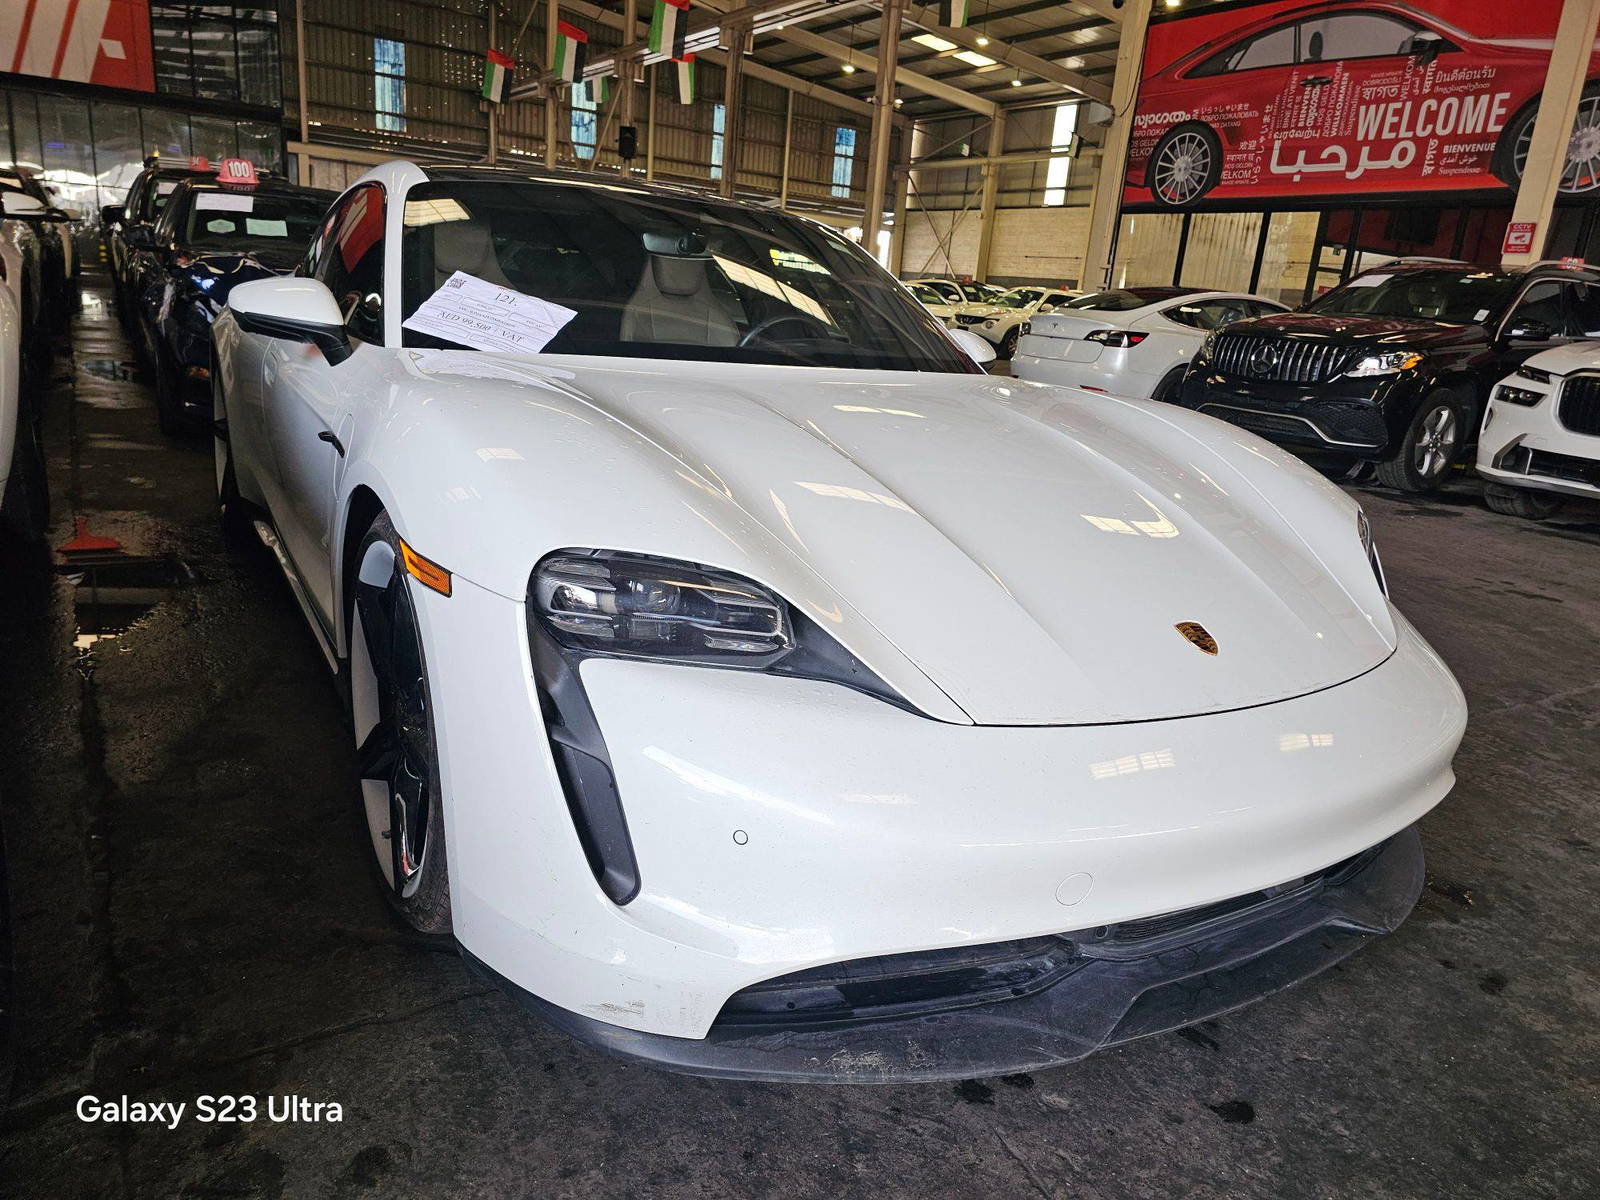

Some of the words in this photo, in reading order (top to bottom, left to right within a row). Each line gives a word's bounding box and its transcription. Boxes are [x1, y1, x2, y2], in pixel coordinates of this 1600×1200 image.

[1400, 55, 1416, 100] WELKOM
[1298, 75, 1314, 127] BIENVENE
[1330, 72, 1350, 137] WILLKOMMEN
[1356, 92, 1511, 141] WELCOME
[1131, 147, 1154, 156] ELKO
[1270, 140, 1416, 182] مرحبا
[1443, 142, 1496, 154] BIENVENUE
[228, 161, 250, 178] 100
[1221, 170, 1252, 179] ELKOM
[501, 329, 525, 343] VAT
